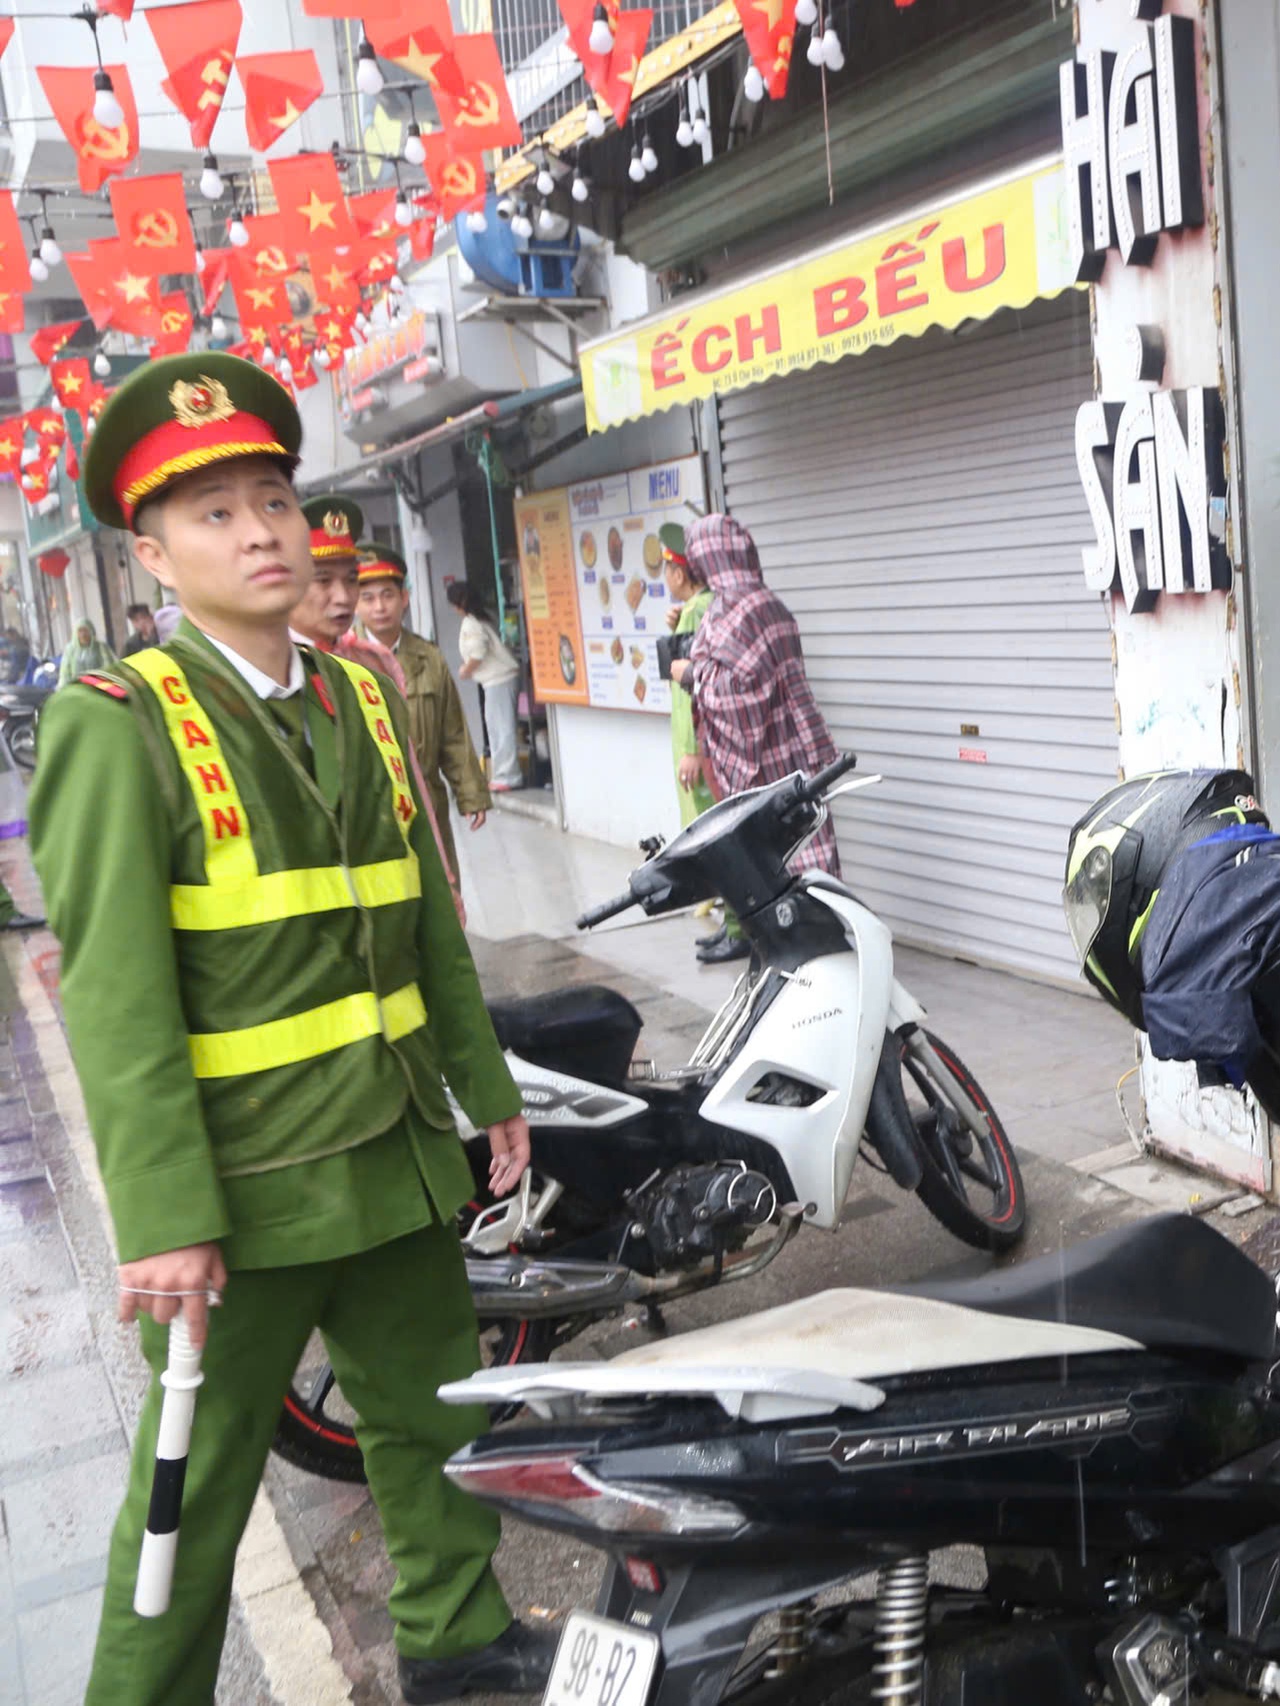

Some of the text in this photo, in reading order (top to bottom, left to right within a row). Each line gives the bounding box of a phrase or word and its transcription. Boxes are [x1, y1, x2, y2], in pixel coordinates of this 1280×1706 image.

[650, 222, 1007, 391] ẾCH BẾU
[648, 466, 680, 502] MENU
